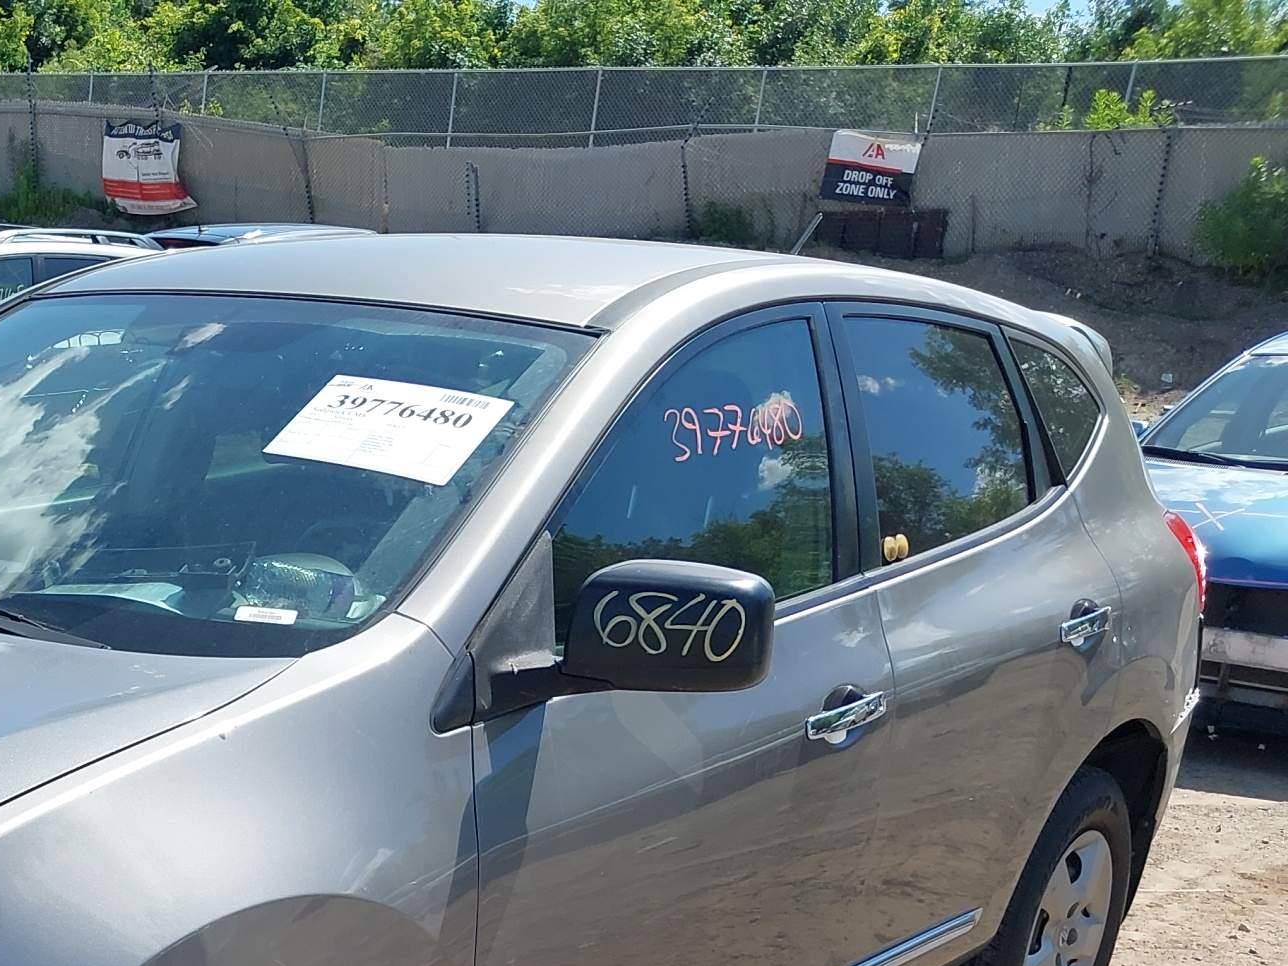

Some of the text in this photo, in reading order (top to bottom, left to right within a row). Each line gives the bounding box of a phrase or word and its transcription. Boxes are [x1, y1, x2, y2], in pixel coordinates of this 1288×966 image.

[835, 182, 897, 200] ZONE ONLY
[843, 169, 894, 188] DROP OFF
[327, 394, 473, 429] 39776480
[664, 402, 803, 462] 39776480
[593, 590, 746, 662] 6840
